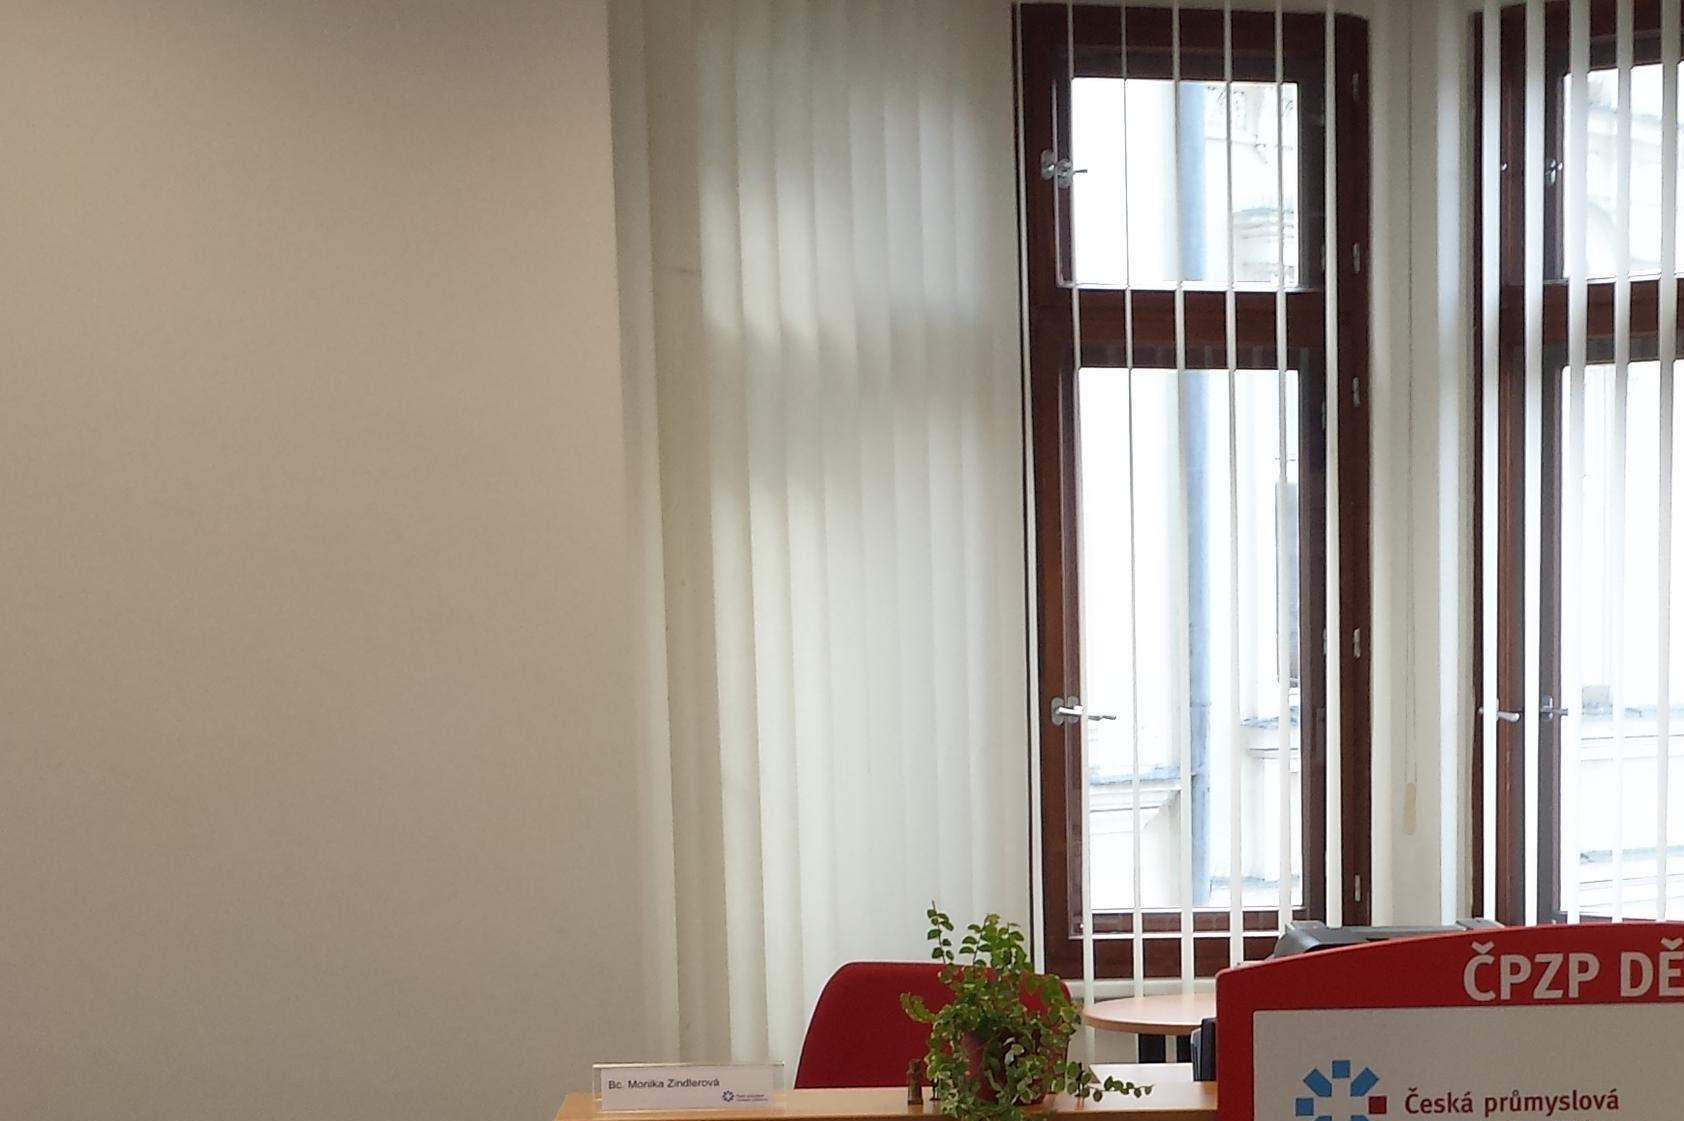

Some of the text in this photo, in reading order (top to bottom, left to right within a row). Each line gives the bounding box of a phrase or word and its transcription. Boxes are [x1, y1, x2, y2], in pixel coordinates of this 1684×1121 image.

[1463, 940, 1600, 1001] ČPZP
[608, 1077, 720, 1090] Bc. Monika Zindlerová
[1404, 1087, 1620, 1117] Česká průmyslová
